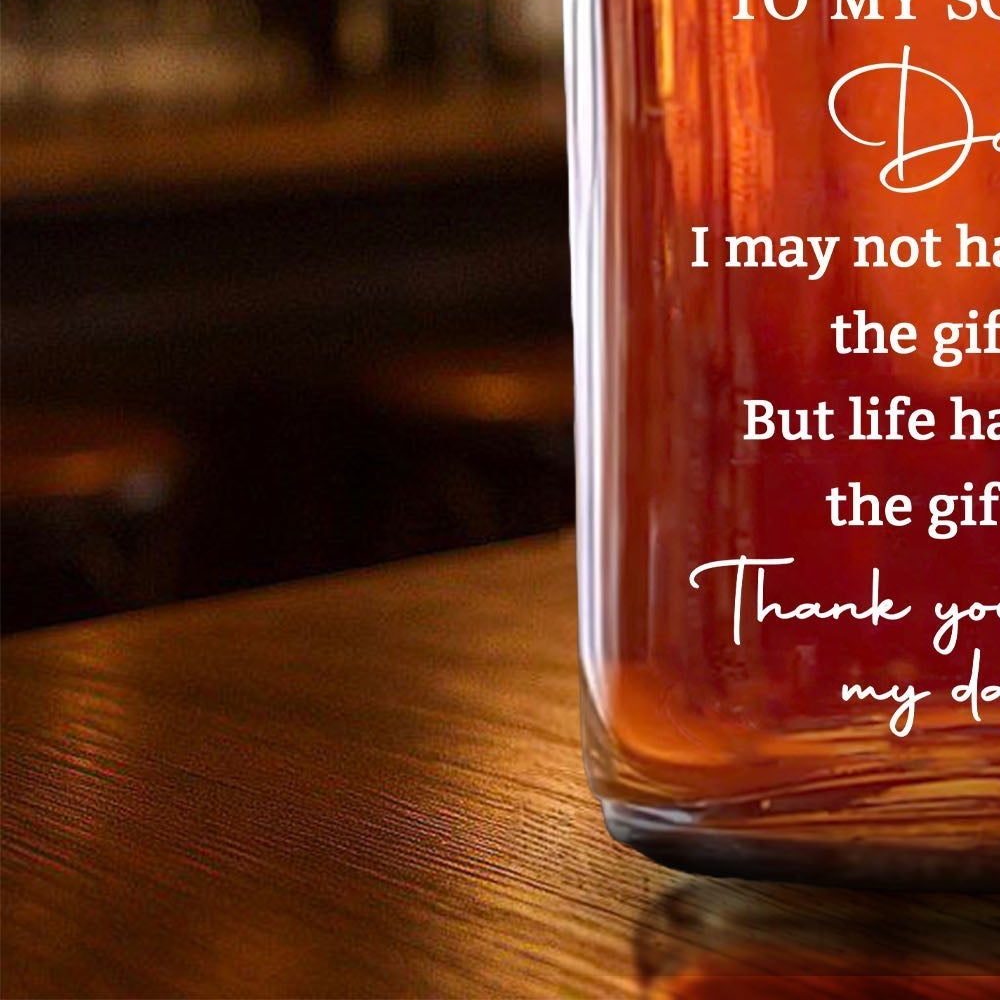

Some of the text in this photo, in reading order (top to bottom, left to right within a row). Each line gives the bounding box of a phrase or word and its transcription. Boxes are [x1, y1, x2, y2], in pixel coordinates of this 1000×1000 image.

[691, 226, 709, 267] I
[725, 235, 841, 281] may
[853, 228, 942, 268] not
[830, 309, 917, 355] the
[743, 399, 835, 441] But
[848, 395, 936, 441] life
[825, 481, 912, 527] the
[688, 554, 912, 646] Thank
[841, 684, 932, 738] my
